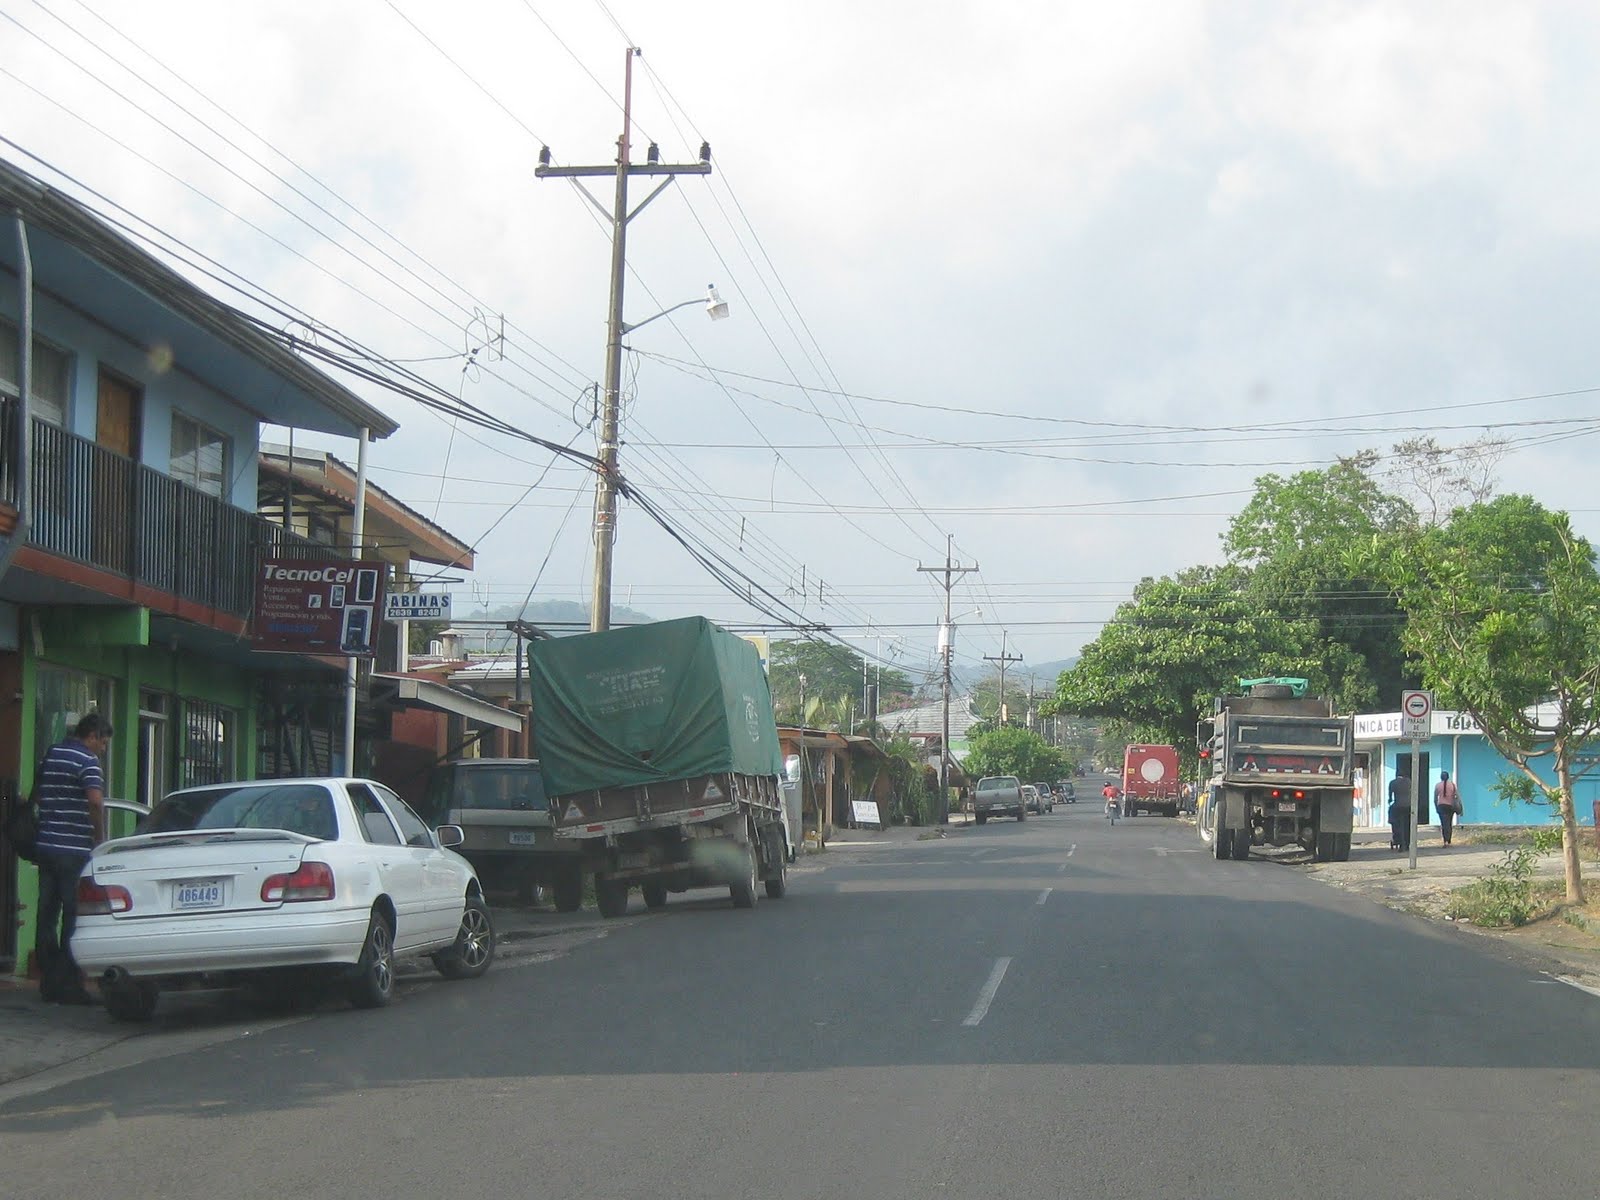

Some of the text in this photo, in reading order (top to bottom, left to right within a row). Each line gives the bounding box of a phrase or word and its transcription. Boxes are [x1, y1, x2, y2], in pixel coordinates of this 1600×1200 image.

[264, 564, 354, 583] TecnoCel
[263, 594, 287, 602] Ventas
[385, 595, 450, 607] ABINAS
[390, 609, 412, 617] 2639
[178, 887, 219, 902] 486449
